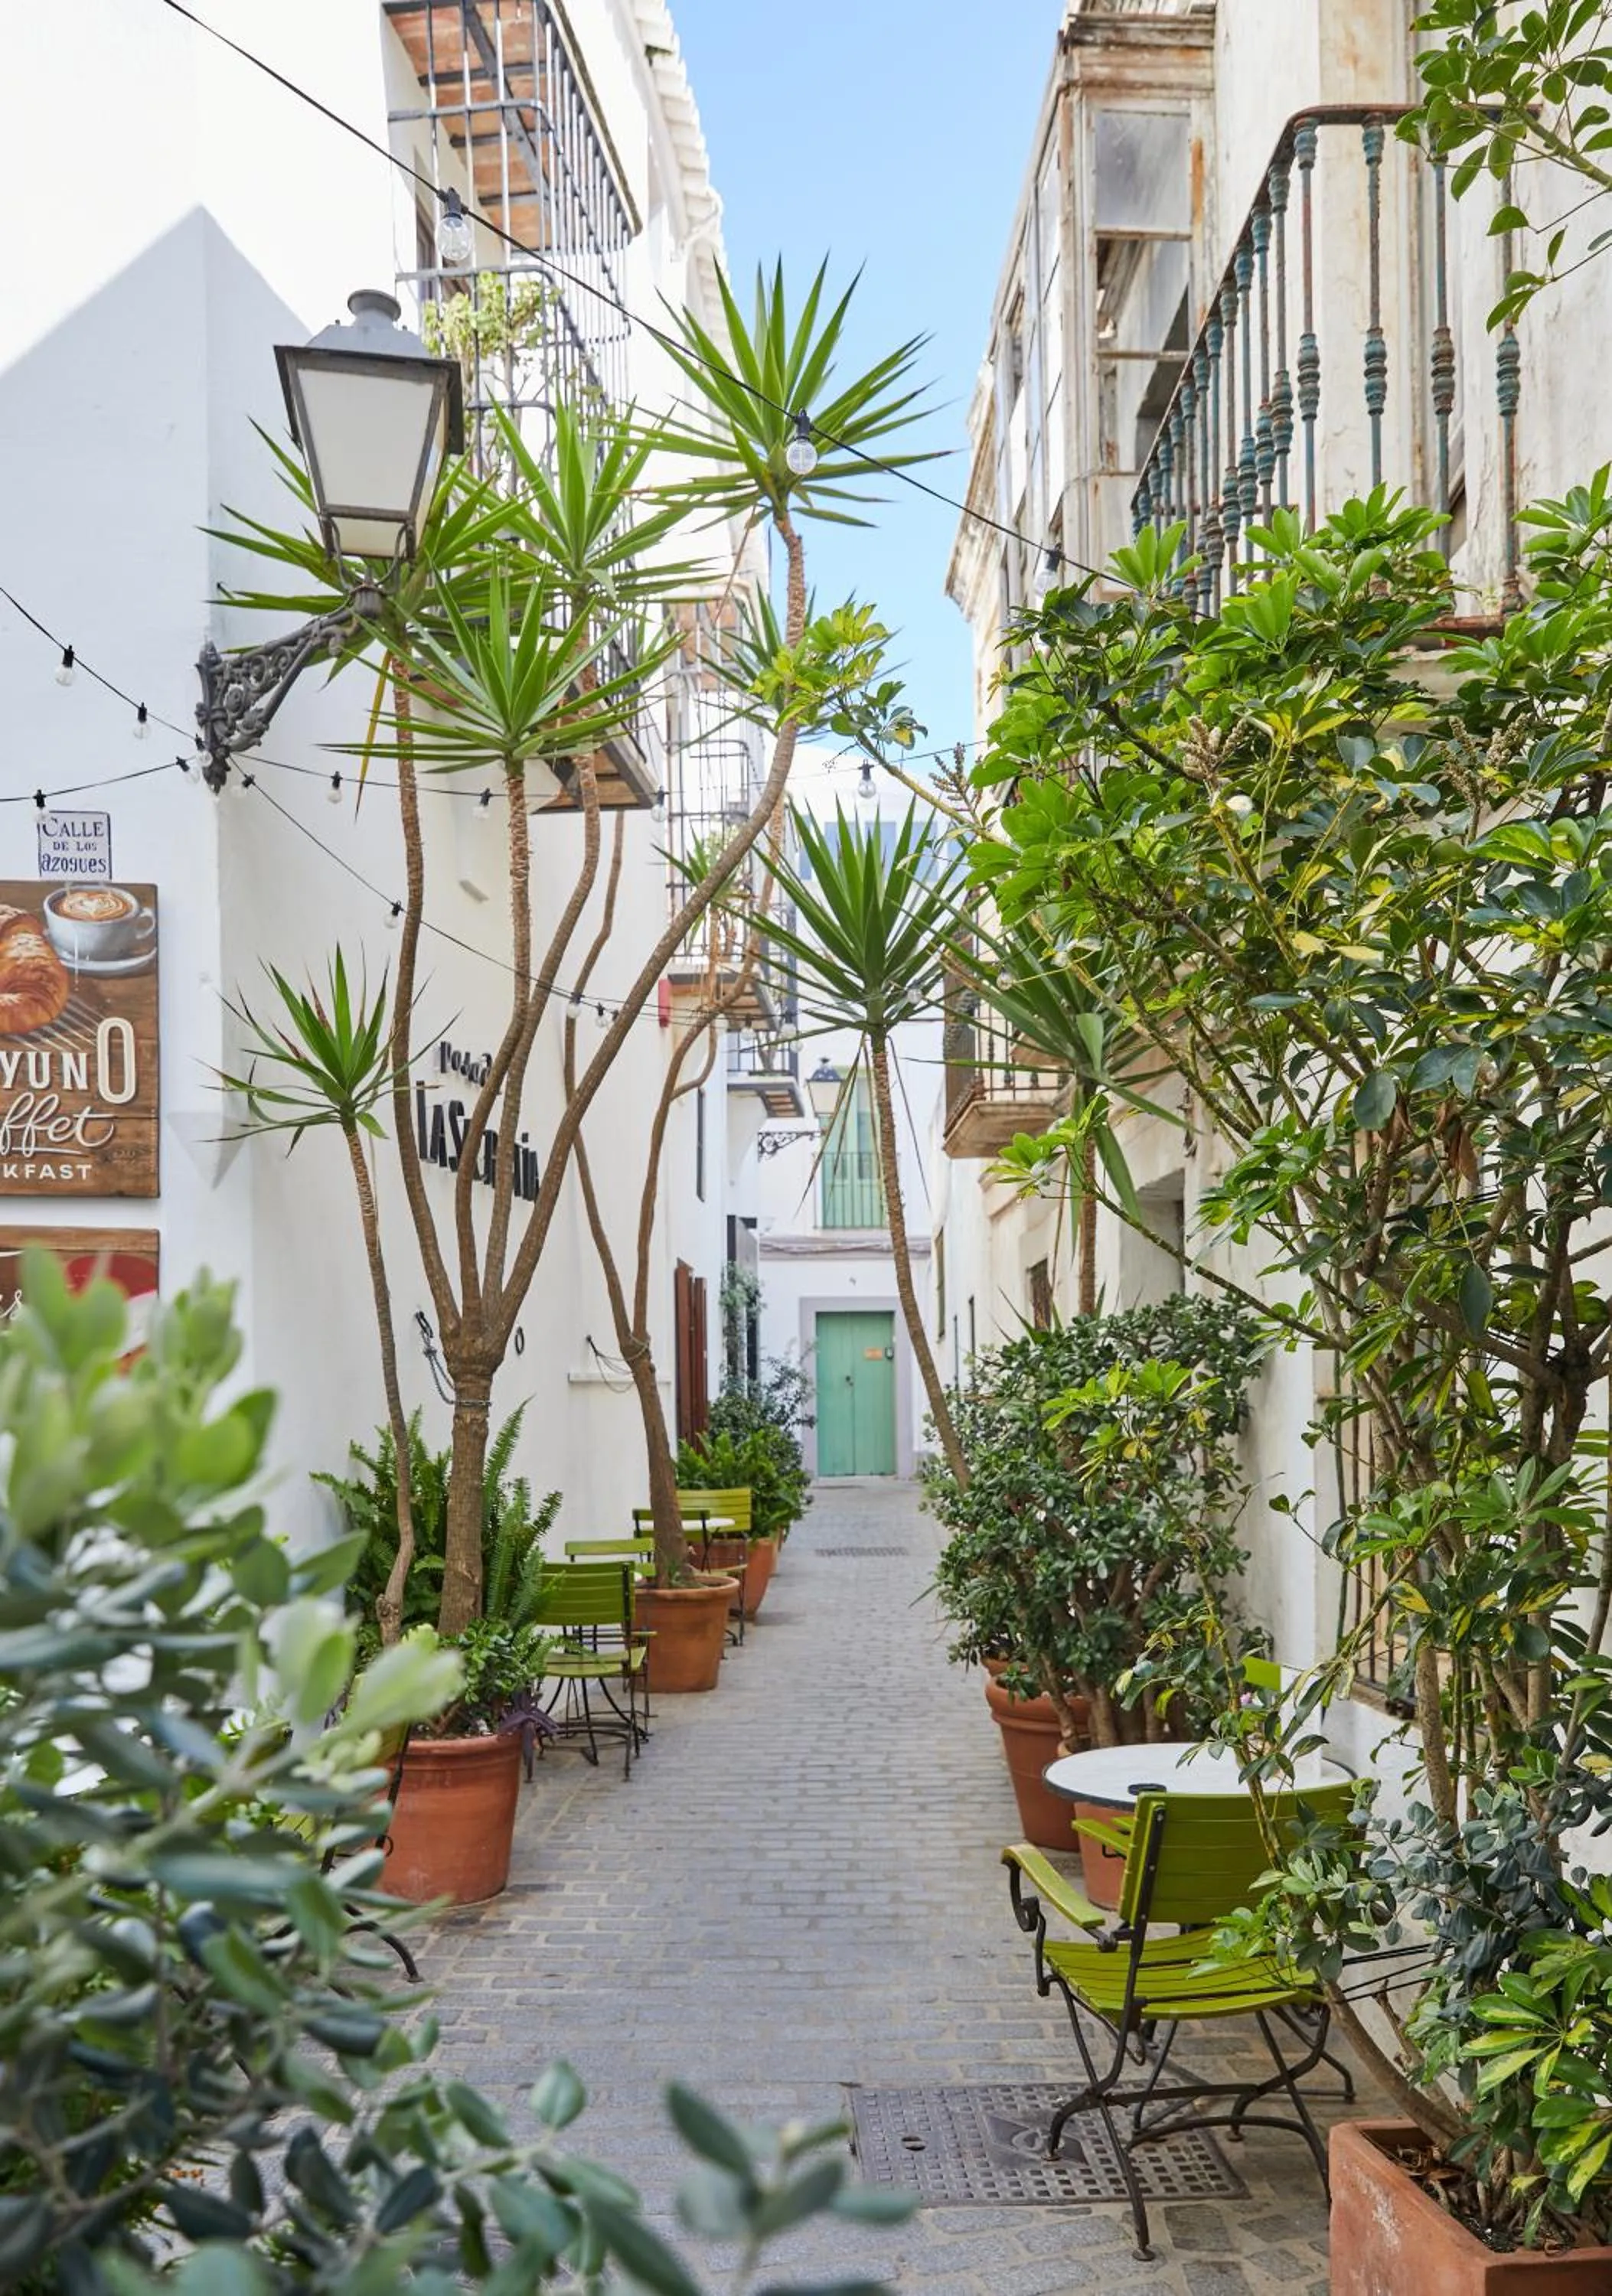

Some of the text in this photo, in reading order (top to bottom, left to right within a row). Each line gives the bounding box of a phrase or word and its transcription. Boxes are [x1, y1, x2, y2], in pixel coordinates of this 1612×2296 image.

[42, 816, 104, 837] CALLE
[53, 841, 69, 851] DE
[3, 1163, 92, 1180] KFAST
